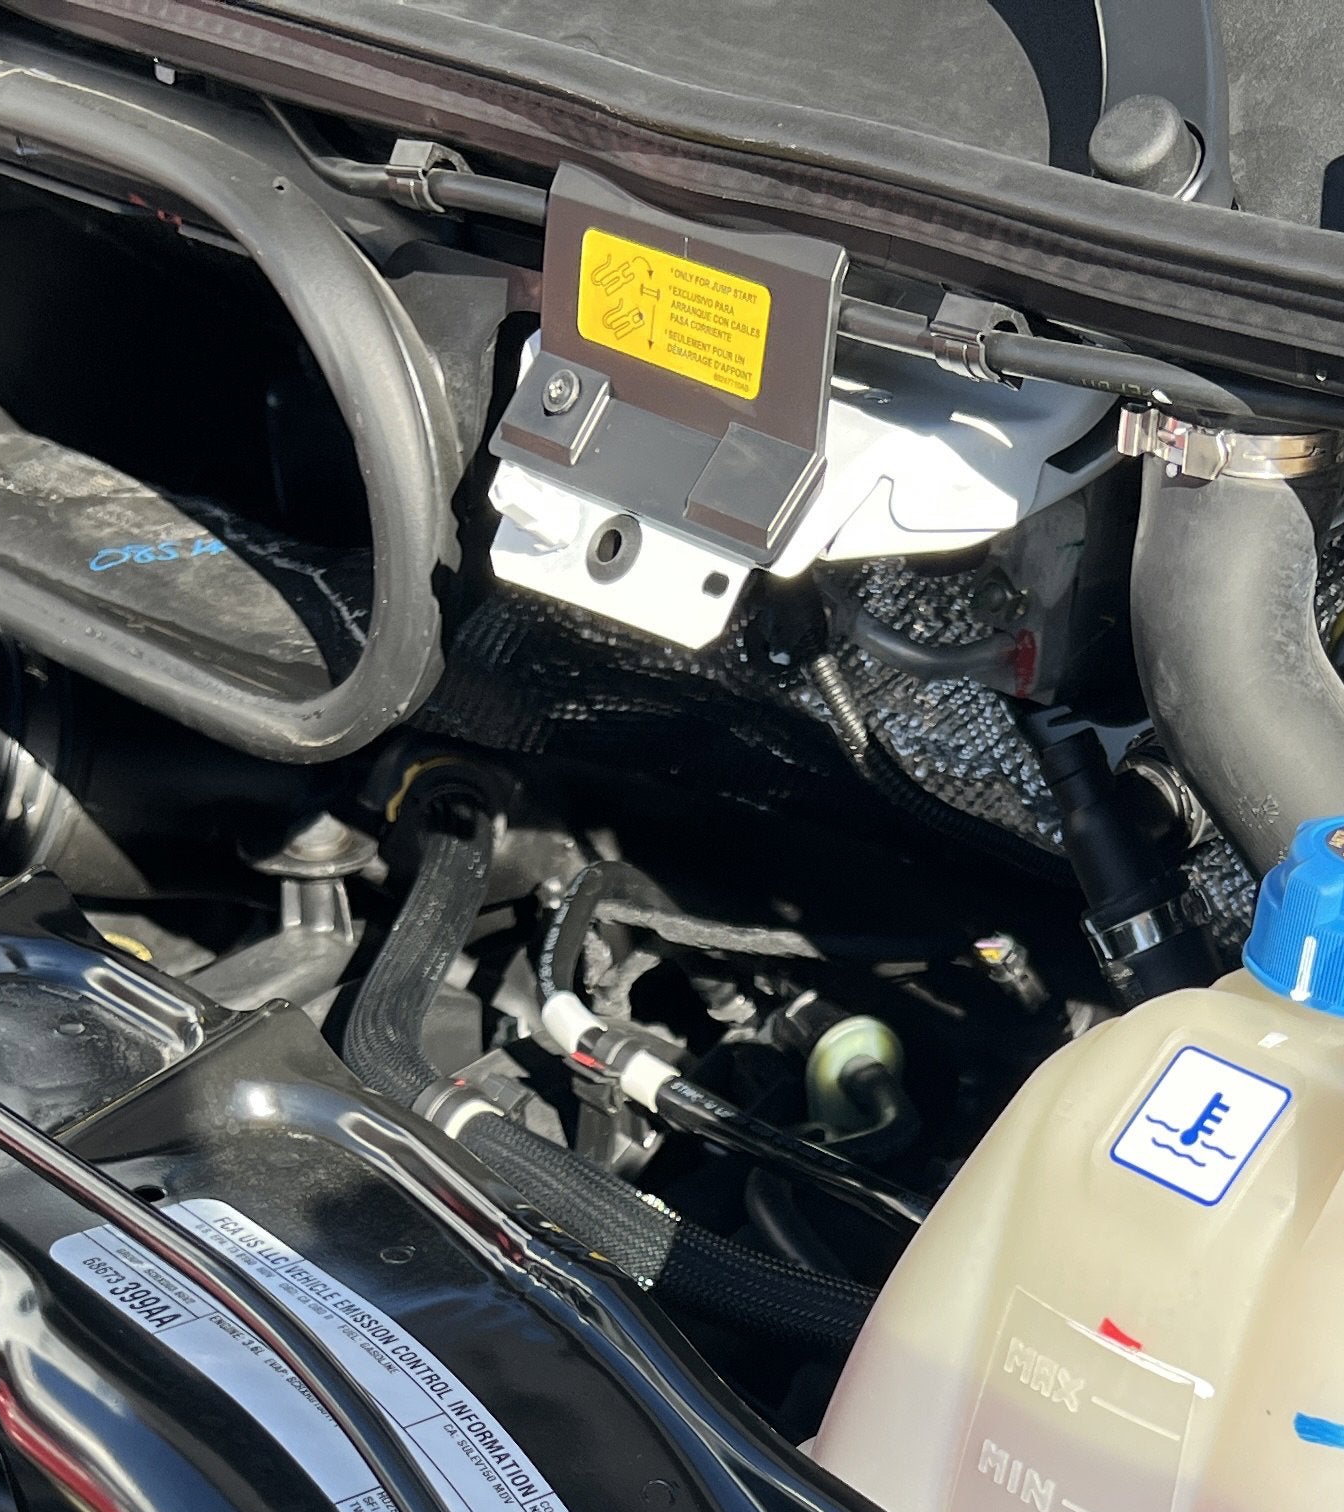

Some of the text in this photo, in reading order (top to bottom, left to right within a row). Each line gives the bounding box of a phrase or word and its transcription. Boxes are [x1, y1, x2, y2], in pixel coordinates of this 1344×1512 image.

[695, 277, 710, 288] FOR
[733, 289, 757, 304] START
[715, 301, 734, 315] PARA
[713, 314, 729, 327] CON
[730, 320, 760, 338] CABLES
[712, 347, 733, 360] POUR
[212, 1216, 290, 1266] FCA US LLC
[359, 1342, 400, 1375] GASOLINE
[285, 1264, 538, 1497] VEHICLE EMISSION CONTROL INFORMATION
[1003, 1337, 1085, 1413] MAX
[362, 1496, 381, 1512] SFI
[493, 1483, 515, 1505] MDV
